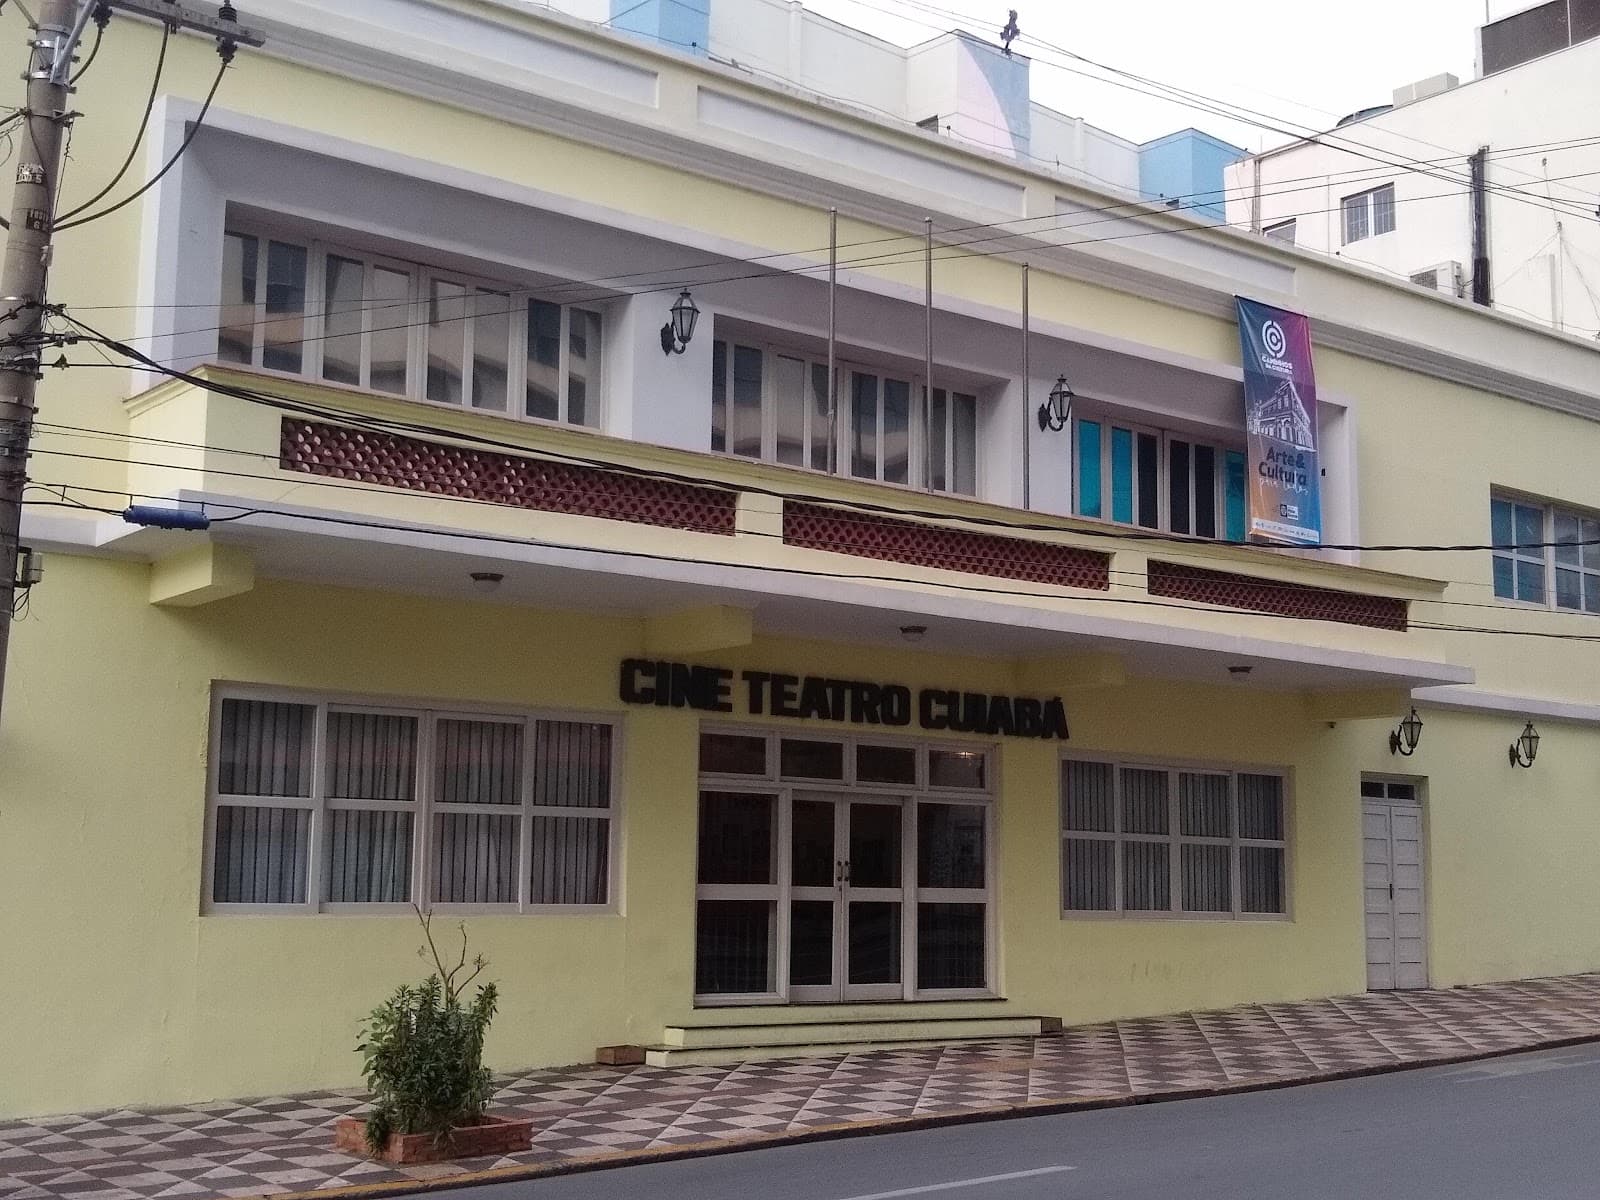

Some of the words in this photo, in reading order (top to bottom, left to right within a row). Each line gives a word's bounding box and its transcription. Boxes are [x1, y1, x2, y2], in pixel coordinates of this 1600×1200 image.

[1258, 461, 1307, 486] Cultura
[619, 657, 734, 713] CINE
[741, 670, 911, 726] TEATRO
[918, 688, 1070, 740] CUIABÁ
